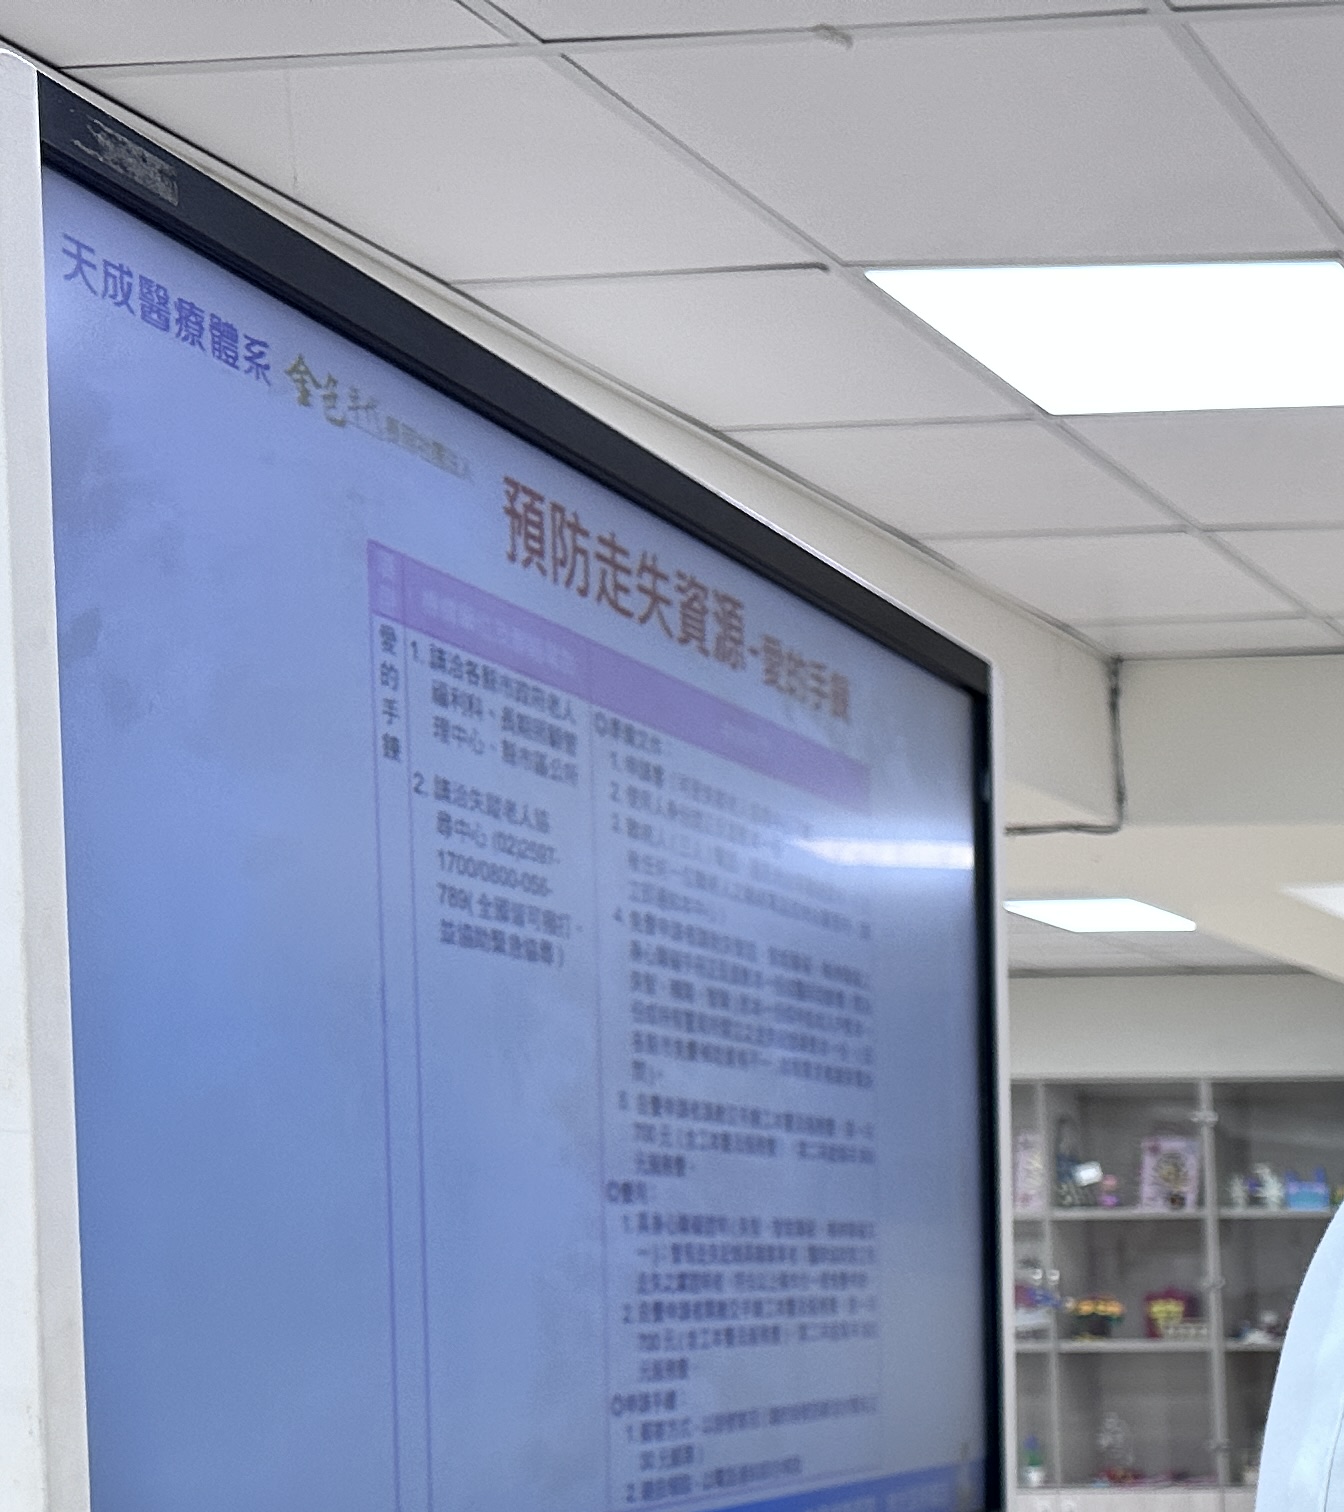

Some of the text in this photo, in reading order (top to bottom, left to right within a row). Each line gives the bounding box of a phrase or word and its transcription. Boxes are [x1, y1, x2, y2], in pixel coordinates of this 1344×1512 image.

[61, 232, 271, 386] 天成醫療體系
